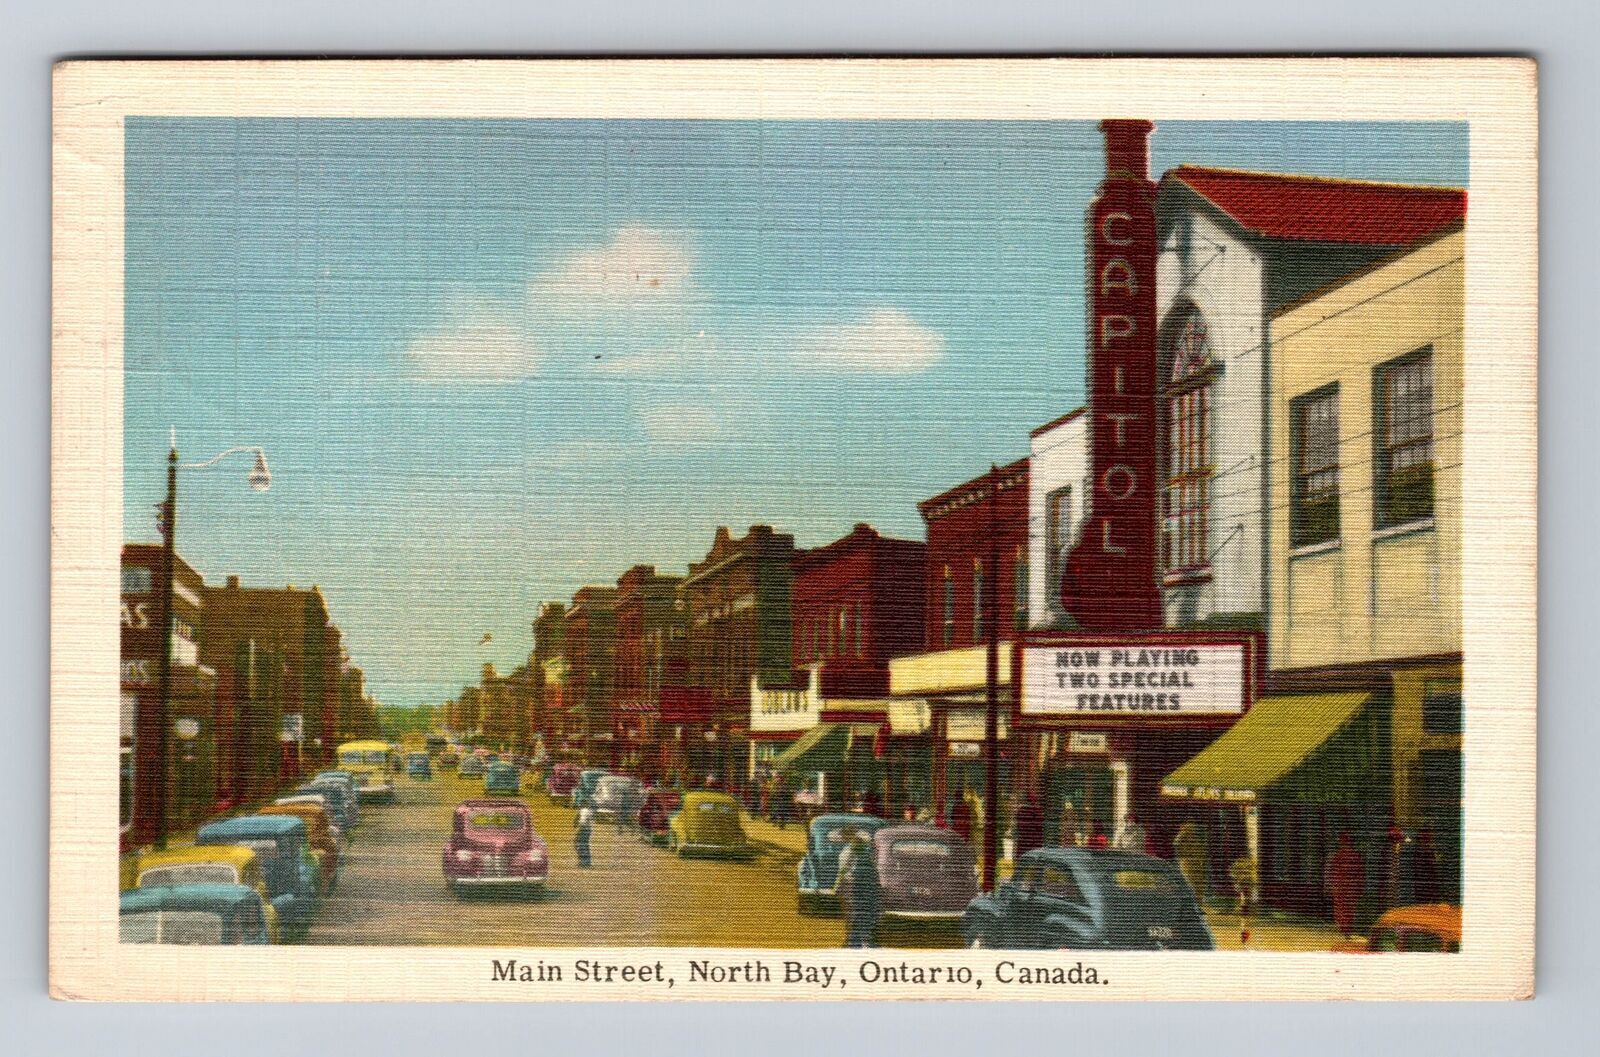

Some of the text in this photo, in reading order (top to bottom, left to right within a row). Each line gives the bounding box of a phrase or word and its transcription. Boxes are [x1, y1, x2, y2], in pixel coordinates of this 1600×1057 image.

[1100, 210, 1140, 556] CAPITOL
[1055, 649, 1200, 668] NOW PLAYING
[1055, 671, 1194, 689] TWO SPECIAL
[1075, 693, 1181, 711] FEATURES
[491, 960, 1109, 989] Main Street, North Bay, Ontario, Canada.
